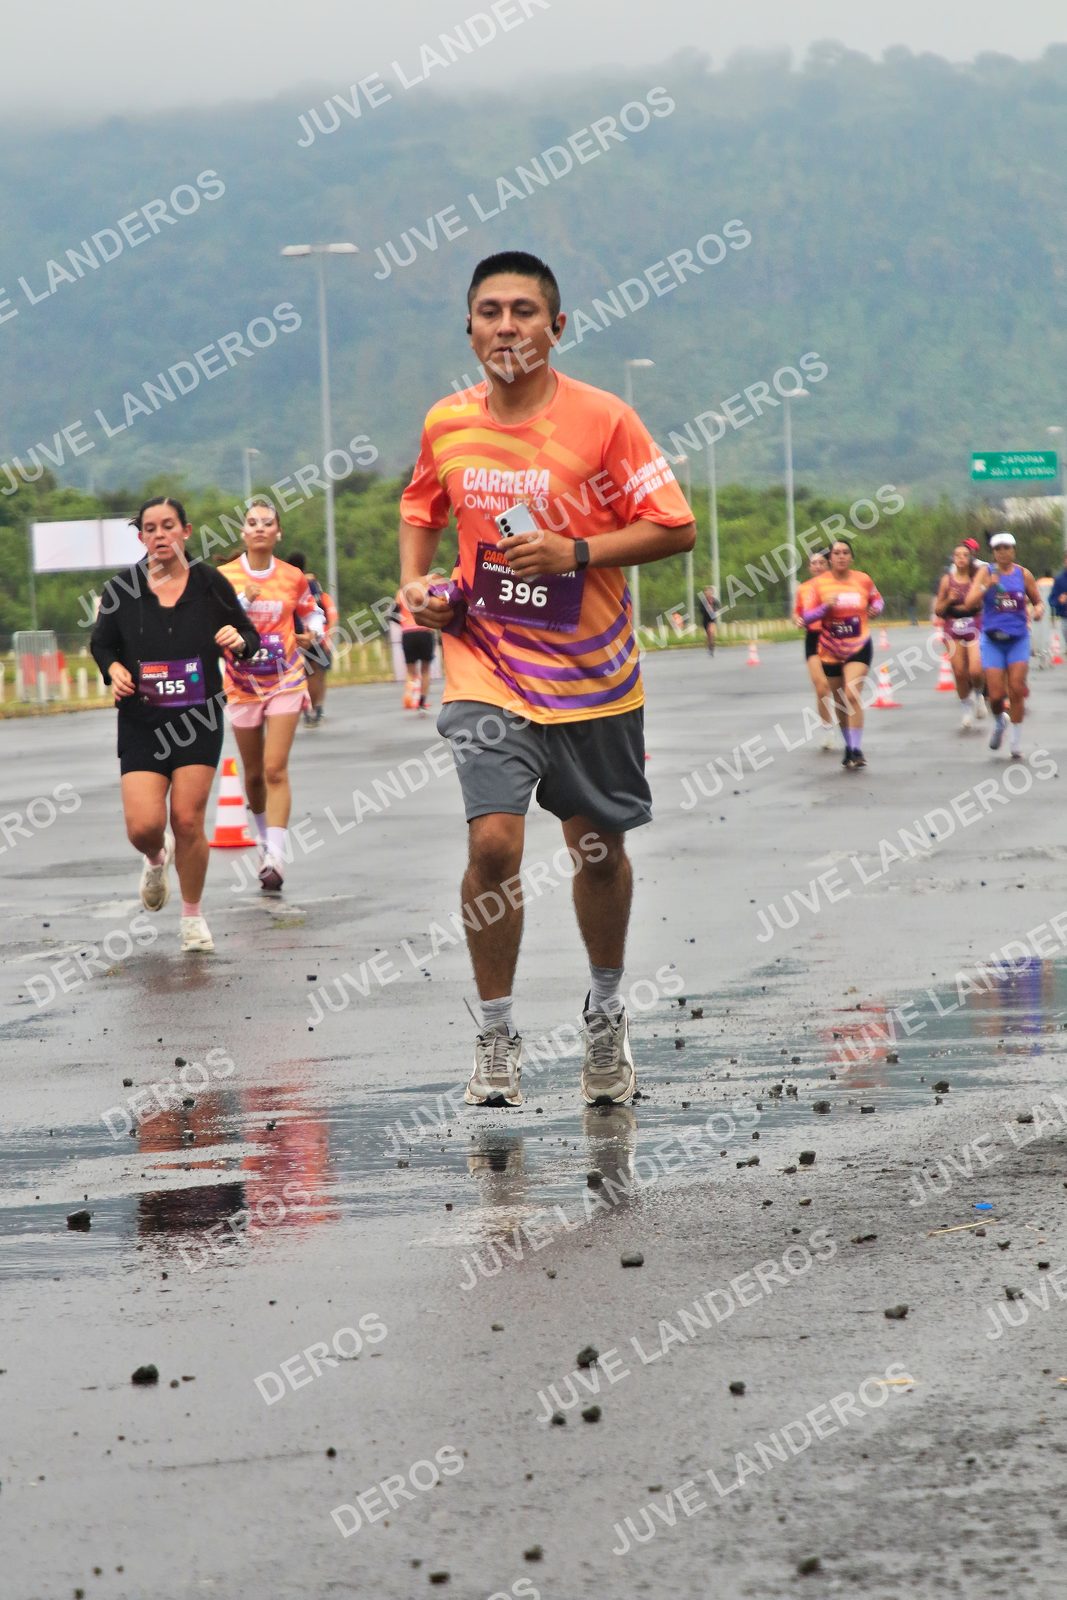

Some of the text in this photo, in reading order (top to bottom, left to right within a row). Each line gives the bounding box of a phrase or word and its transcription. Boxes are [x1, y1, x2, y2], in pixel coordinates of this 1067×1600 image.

[462, 467, 551, 495] CARRERA
[498, 579, 549, 608] 396
[155, 680, 186, 695] 155
